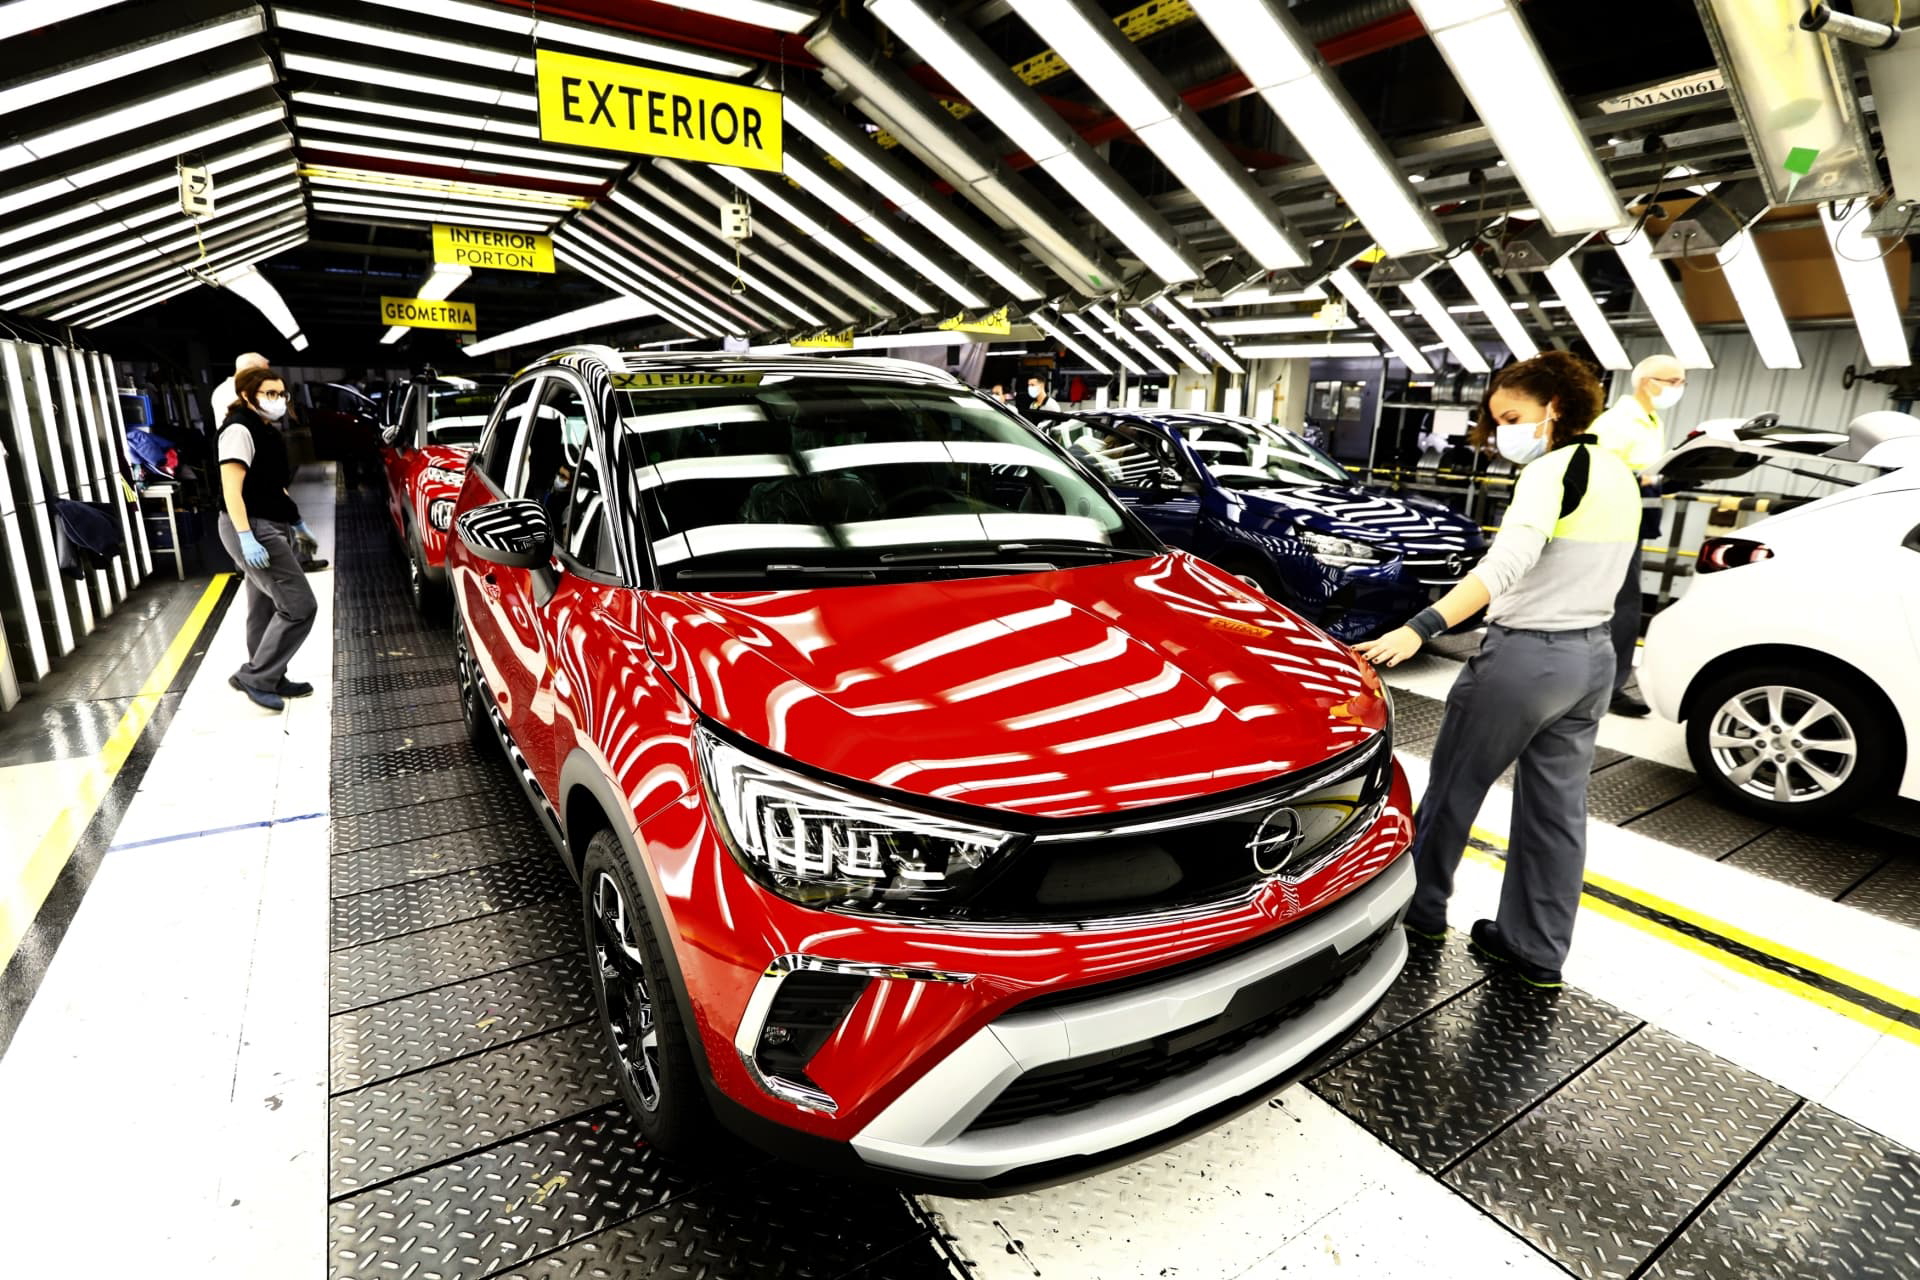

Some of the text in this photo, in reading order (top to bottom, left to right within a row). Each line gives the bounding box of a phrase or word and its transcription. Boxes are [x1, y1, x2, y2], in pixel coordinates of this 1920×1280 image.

[562, 76, 763, 150] EXTERIOR
[450, 228, 536, 250] INTERIOR
[456, 249, 534, 268] PORTON
[386, 303, 473, 324] GEOMETRIA
